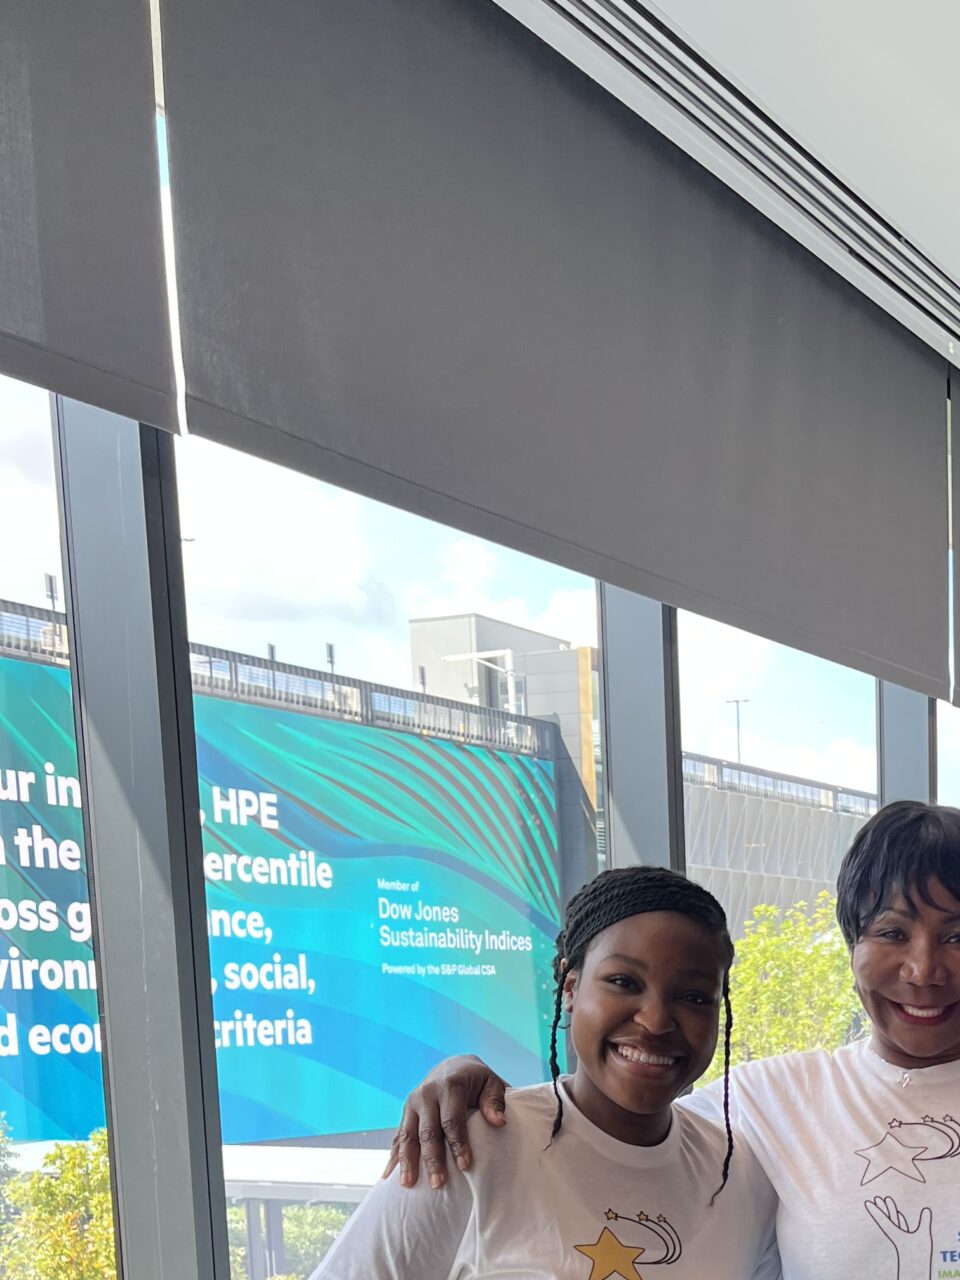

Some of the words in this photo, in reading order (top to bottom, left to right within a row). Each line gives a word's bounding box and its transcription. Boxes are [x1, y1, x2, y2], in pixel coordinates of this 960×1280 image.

[212, 786, 279, 829] HPE
[14, 825, 81, 871] the
[377, 878, 410, 891] Member
[411, 880, 419, 892] of
[207, 909, 273, 944] nce,
[378, 897, 412, 920] Dow
[414, 900, 459, 923] Jones
[379, 924, 482, 955] Sustainability
[485, 929, 533, 951] Indices
[0, 946, 97, 990] iron
[224, 952, 316, 995] social,
[382, 962, 415, 975] Powered
[417, 964, 426, 977] by
[427, 964, 440, 975] the
[441, 964, 457, 976] S&P
[458, 964, 481, 976] Global
[481, 965, 497, 976] CSA
